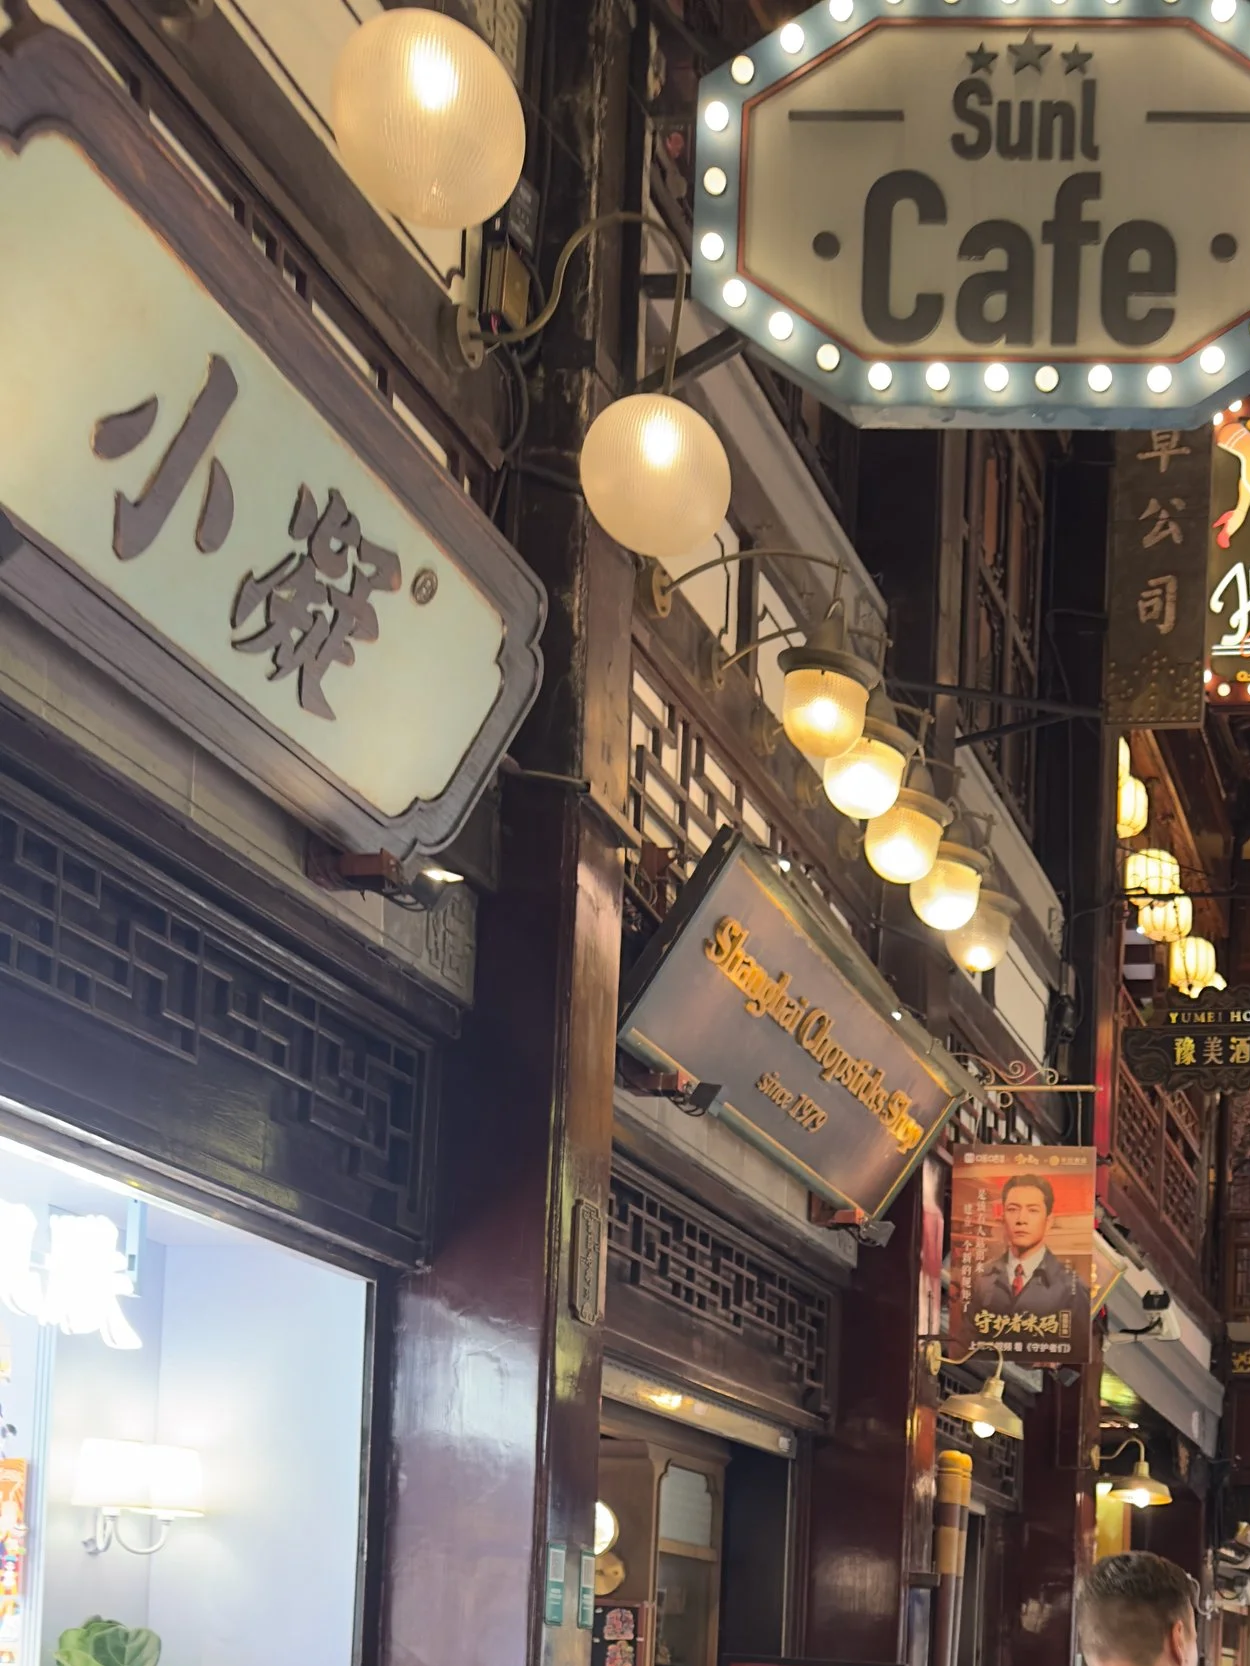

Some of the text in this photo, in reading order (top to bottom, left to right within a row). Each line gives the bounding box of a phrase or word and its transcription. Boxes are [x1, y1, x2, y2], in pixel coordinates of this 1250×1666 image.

[861, 169, 1178, 350] Cafe
[704, 915, 810, 1036] Shanghai
[880, 1089, 925, 1156] Shop
[1169, 1011, 1221, 1024] YUMEI
[756, 1071, 829, 1134] since 1979
